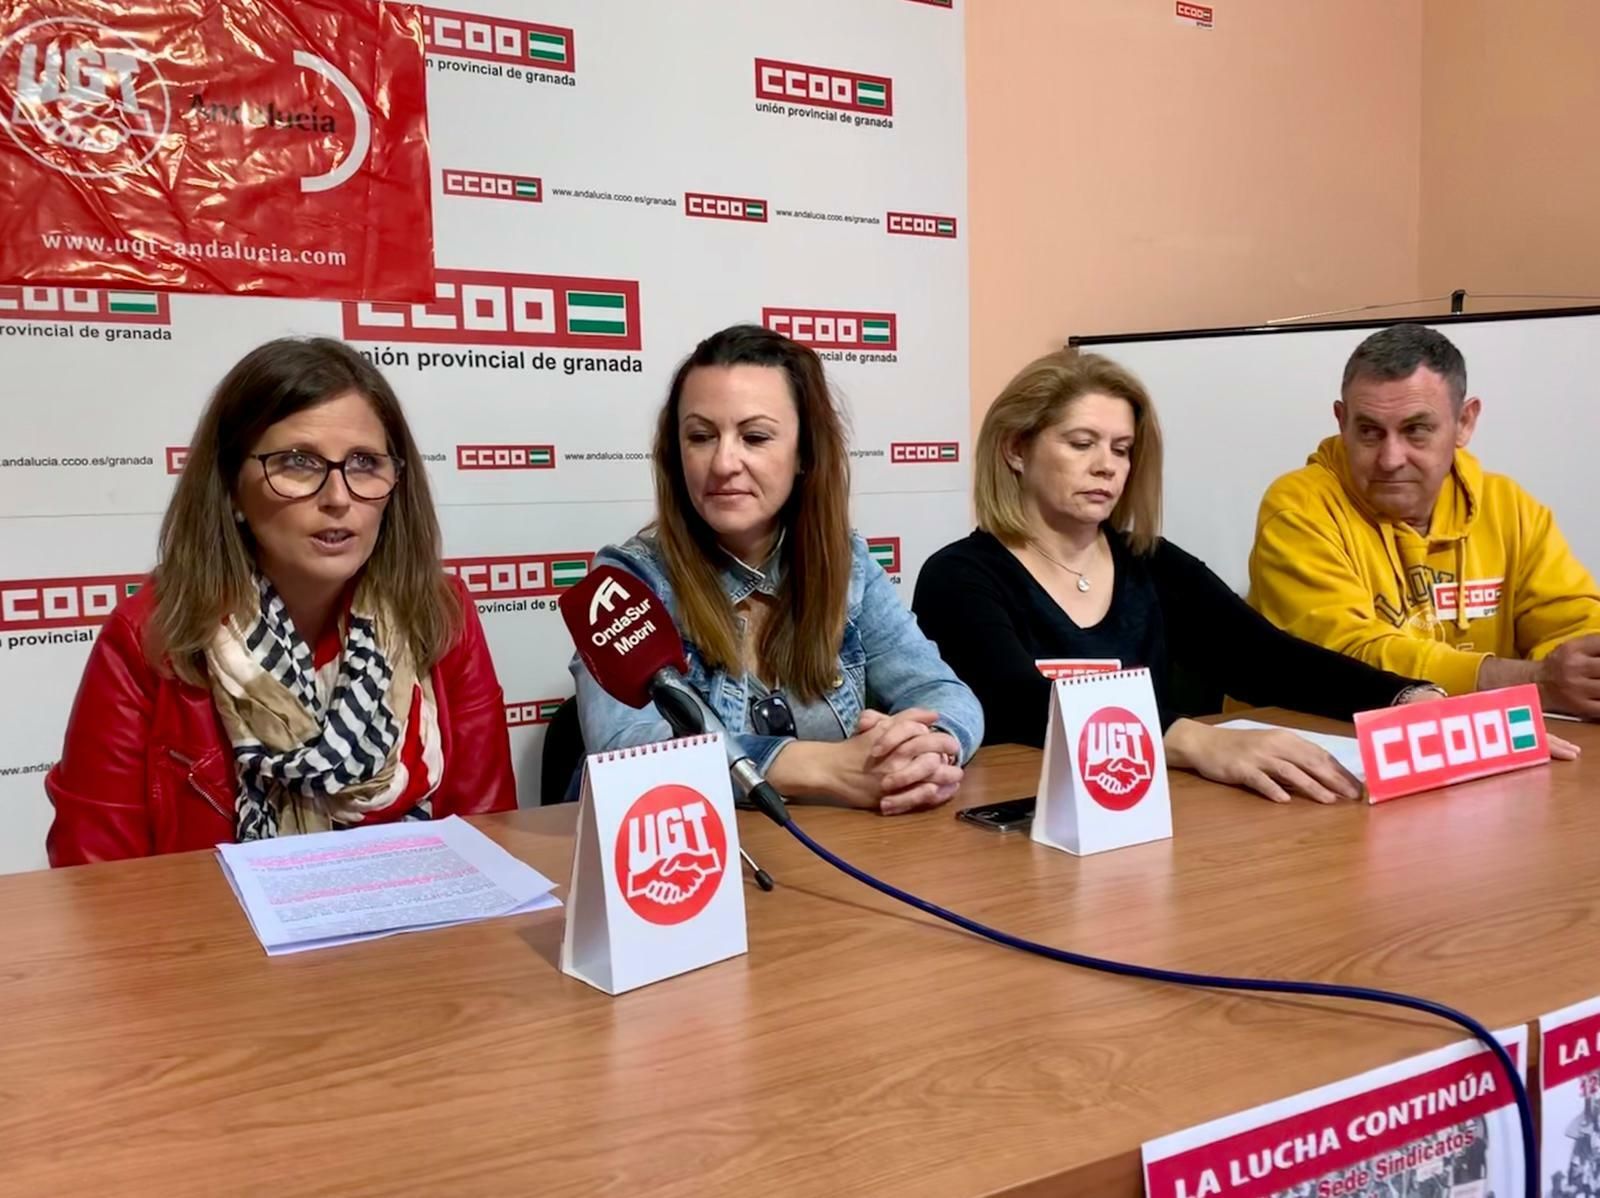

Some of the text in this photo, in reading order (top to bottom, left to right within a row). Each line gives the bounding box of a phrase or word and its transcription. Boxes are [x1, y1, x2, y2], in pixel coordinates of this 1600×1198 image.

[16, 42, 141, 113] UGT
[438, 60, 503, 77] provincial
[507, 67, 522, 79] de
[526, 72, 576, 87] granada
[761, 66, 853, 104] CCOO
[755, 102, 893, 129] unión provincial de granada
[447, 173, 513, 196] CCOO
[552, 187, 677, 207] www.andalucia.ccoo.es/granada
[688, 197, 744, 217] CCOO
[776, 208, 880, 225] www.andalucia.ccoo.es/granada
[889, 216, 936, 234] CCOO
[41, 233, 348, 267] www.ugt-andalucia.com
[0, 324, 173, 342] rovincial de granada
[360, 346, 643, 375] nión provincial de granada
[844, 352, 857, 362] de
[859, 353, 898, 364] granada
[461, 449, 527, 466] CCOO
[893, 446, 939, 460] CCOO
[477, 600, 527, 614] ovincial
[530, 599, 546, 610] de
[591, 598, 652, 647] OndaSur
[8, 629, 94, 650] provincial
[613, 620, 657, 656] Motril
[1087, 721, 1144, 762] UGT
[1370, 708, 1509, 781] CCOO
[627, 800, 711, 870] UGT
[1558, 1037, 1591, 1068] LA
[1174, 1071, 1497, 1198] LA LUCHA CONTINÚA
[1317, 1129, 1476, 1198] Sede Sindicatos
